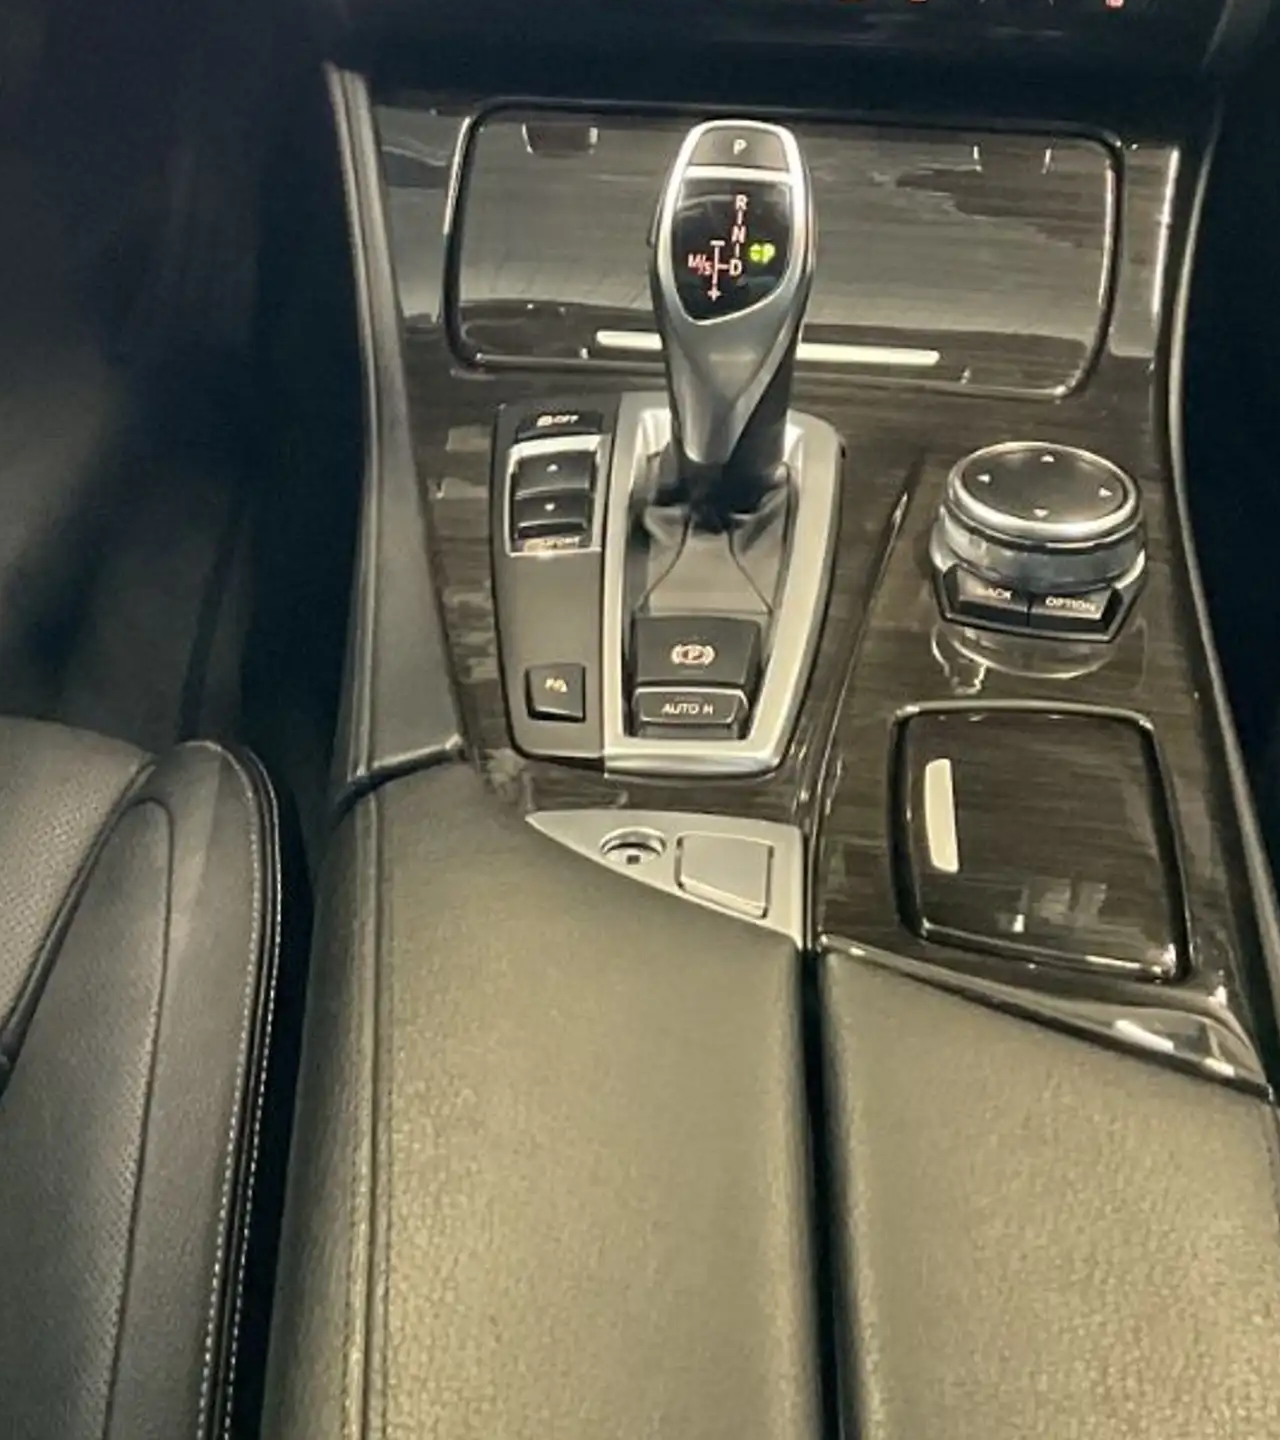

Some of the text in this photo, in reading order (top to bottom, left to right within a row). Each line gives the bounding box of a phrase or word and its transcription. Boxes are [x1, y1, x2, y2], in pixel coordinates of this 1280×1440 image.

[733, 138, 748, 155] P
[735, 194, 748, 210] R
[731, 225, 747, 244] N
[728, 258, 743, 277] D
[662, 702, 699, 715] AUTO
